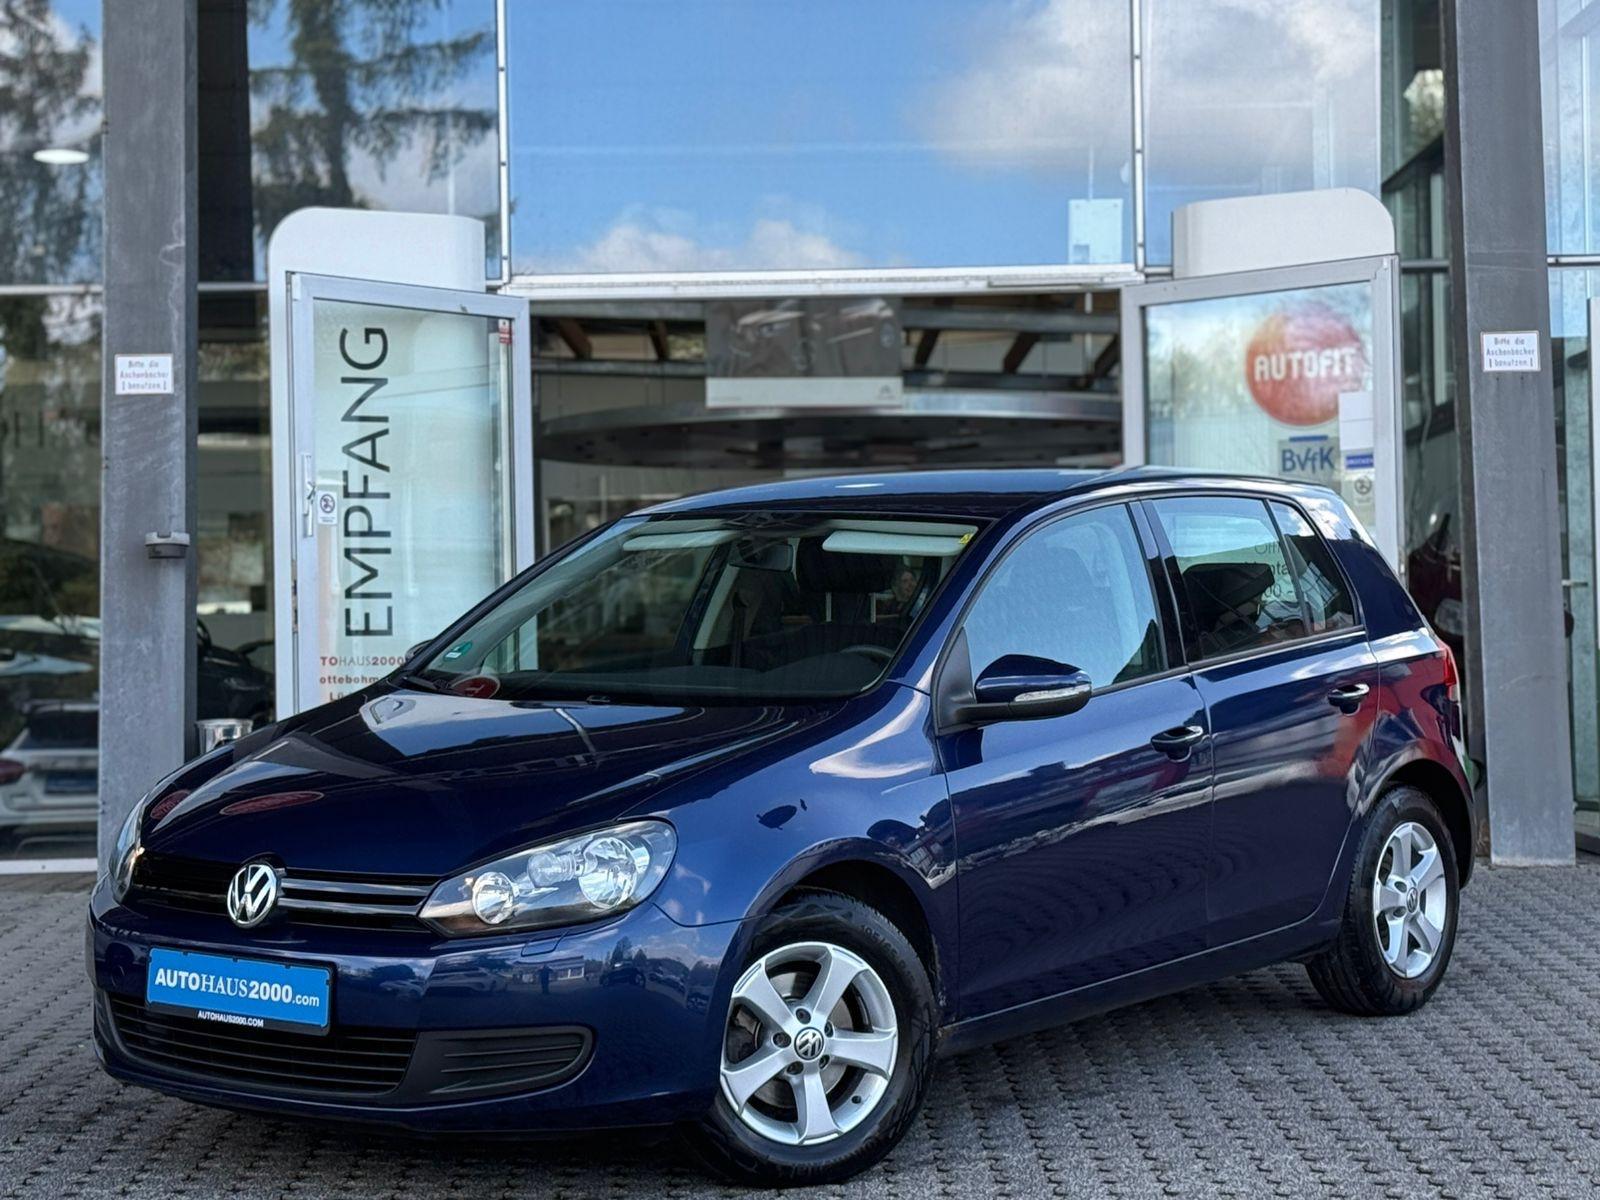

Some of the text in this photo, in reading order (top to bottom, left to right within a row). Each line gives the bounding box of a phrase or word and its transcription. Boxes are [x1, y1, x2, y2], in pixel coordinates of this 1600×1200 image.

[1254, 347, 1356, 381] AUTOFIT
[339, 327, 393, 637] EMPFANG
[154, 967, 320, 1008] AUTOHAUS2000.com
[197, 1010, 264, 1028] AUTOHAUS2000.COM
